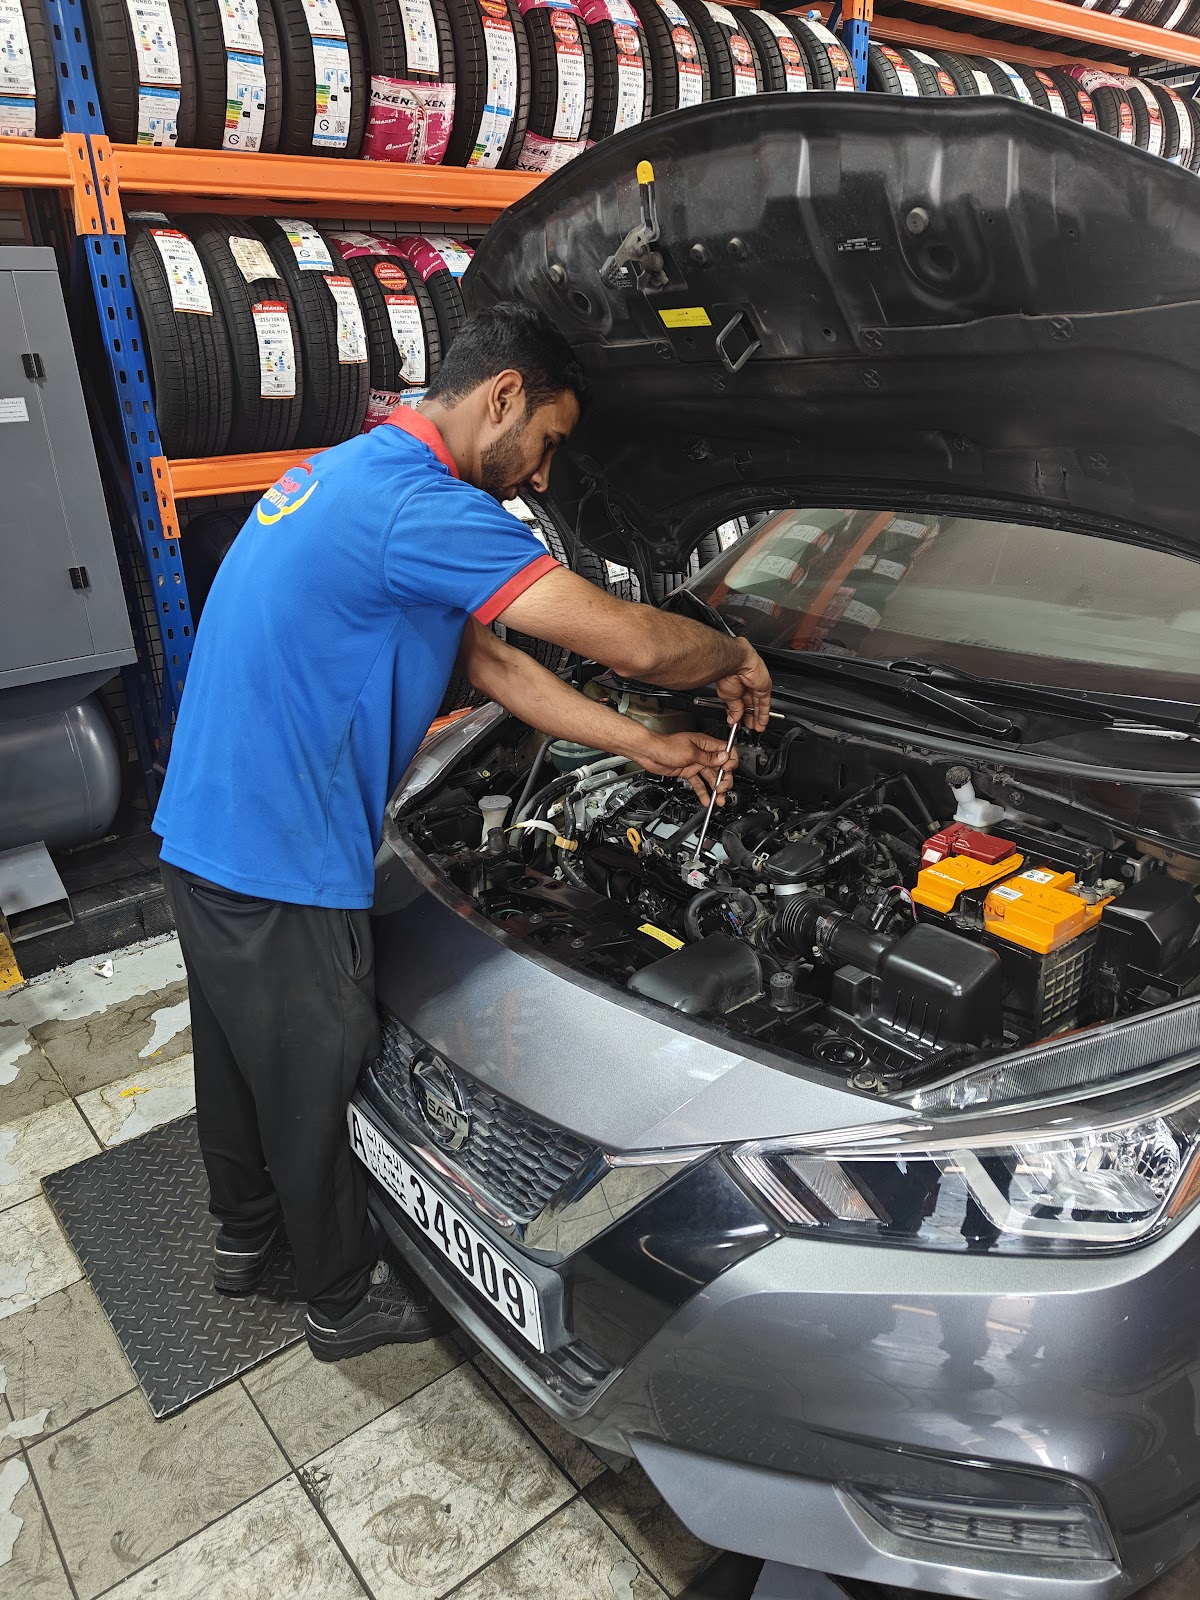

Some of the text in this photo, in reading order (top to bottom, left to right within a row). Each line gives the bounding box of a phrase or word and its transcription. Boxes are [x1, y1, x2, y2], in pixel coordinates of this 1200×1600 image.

[352, 1110, 368, 1162] A
[371, 1160, 408, 1206] عجمان
[410, 1174, 526, 1328] 34909
